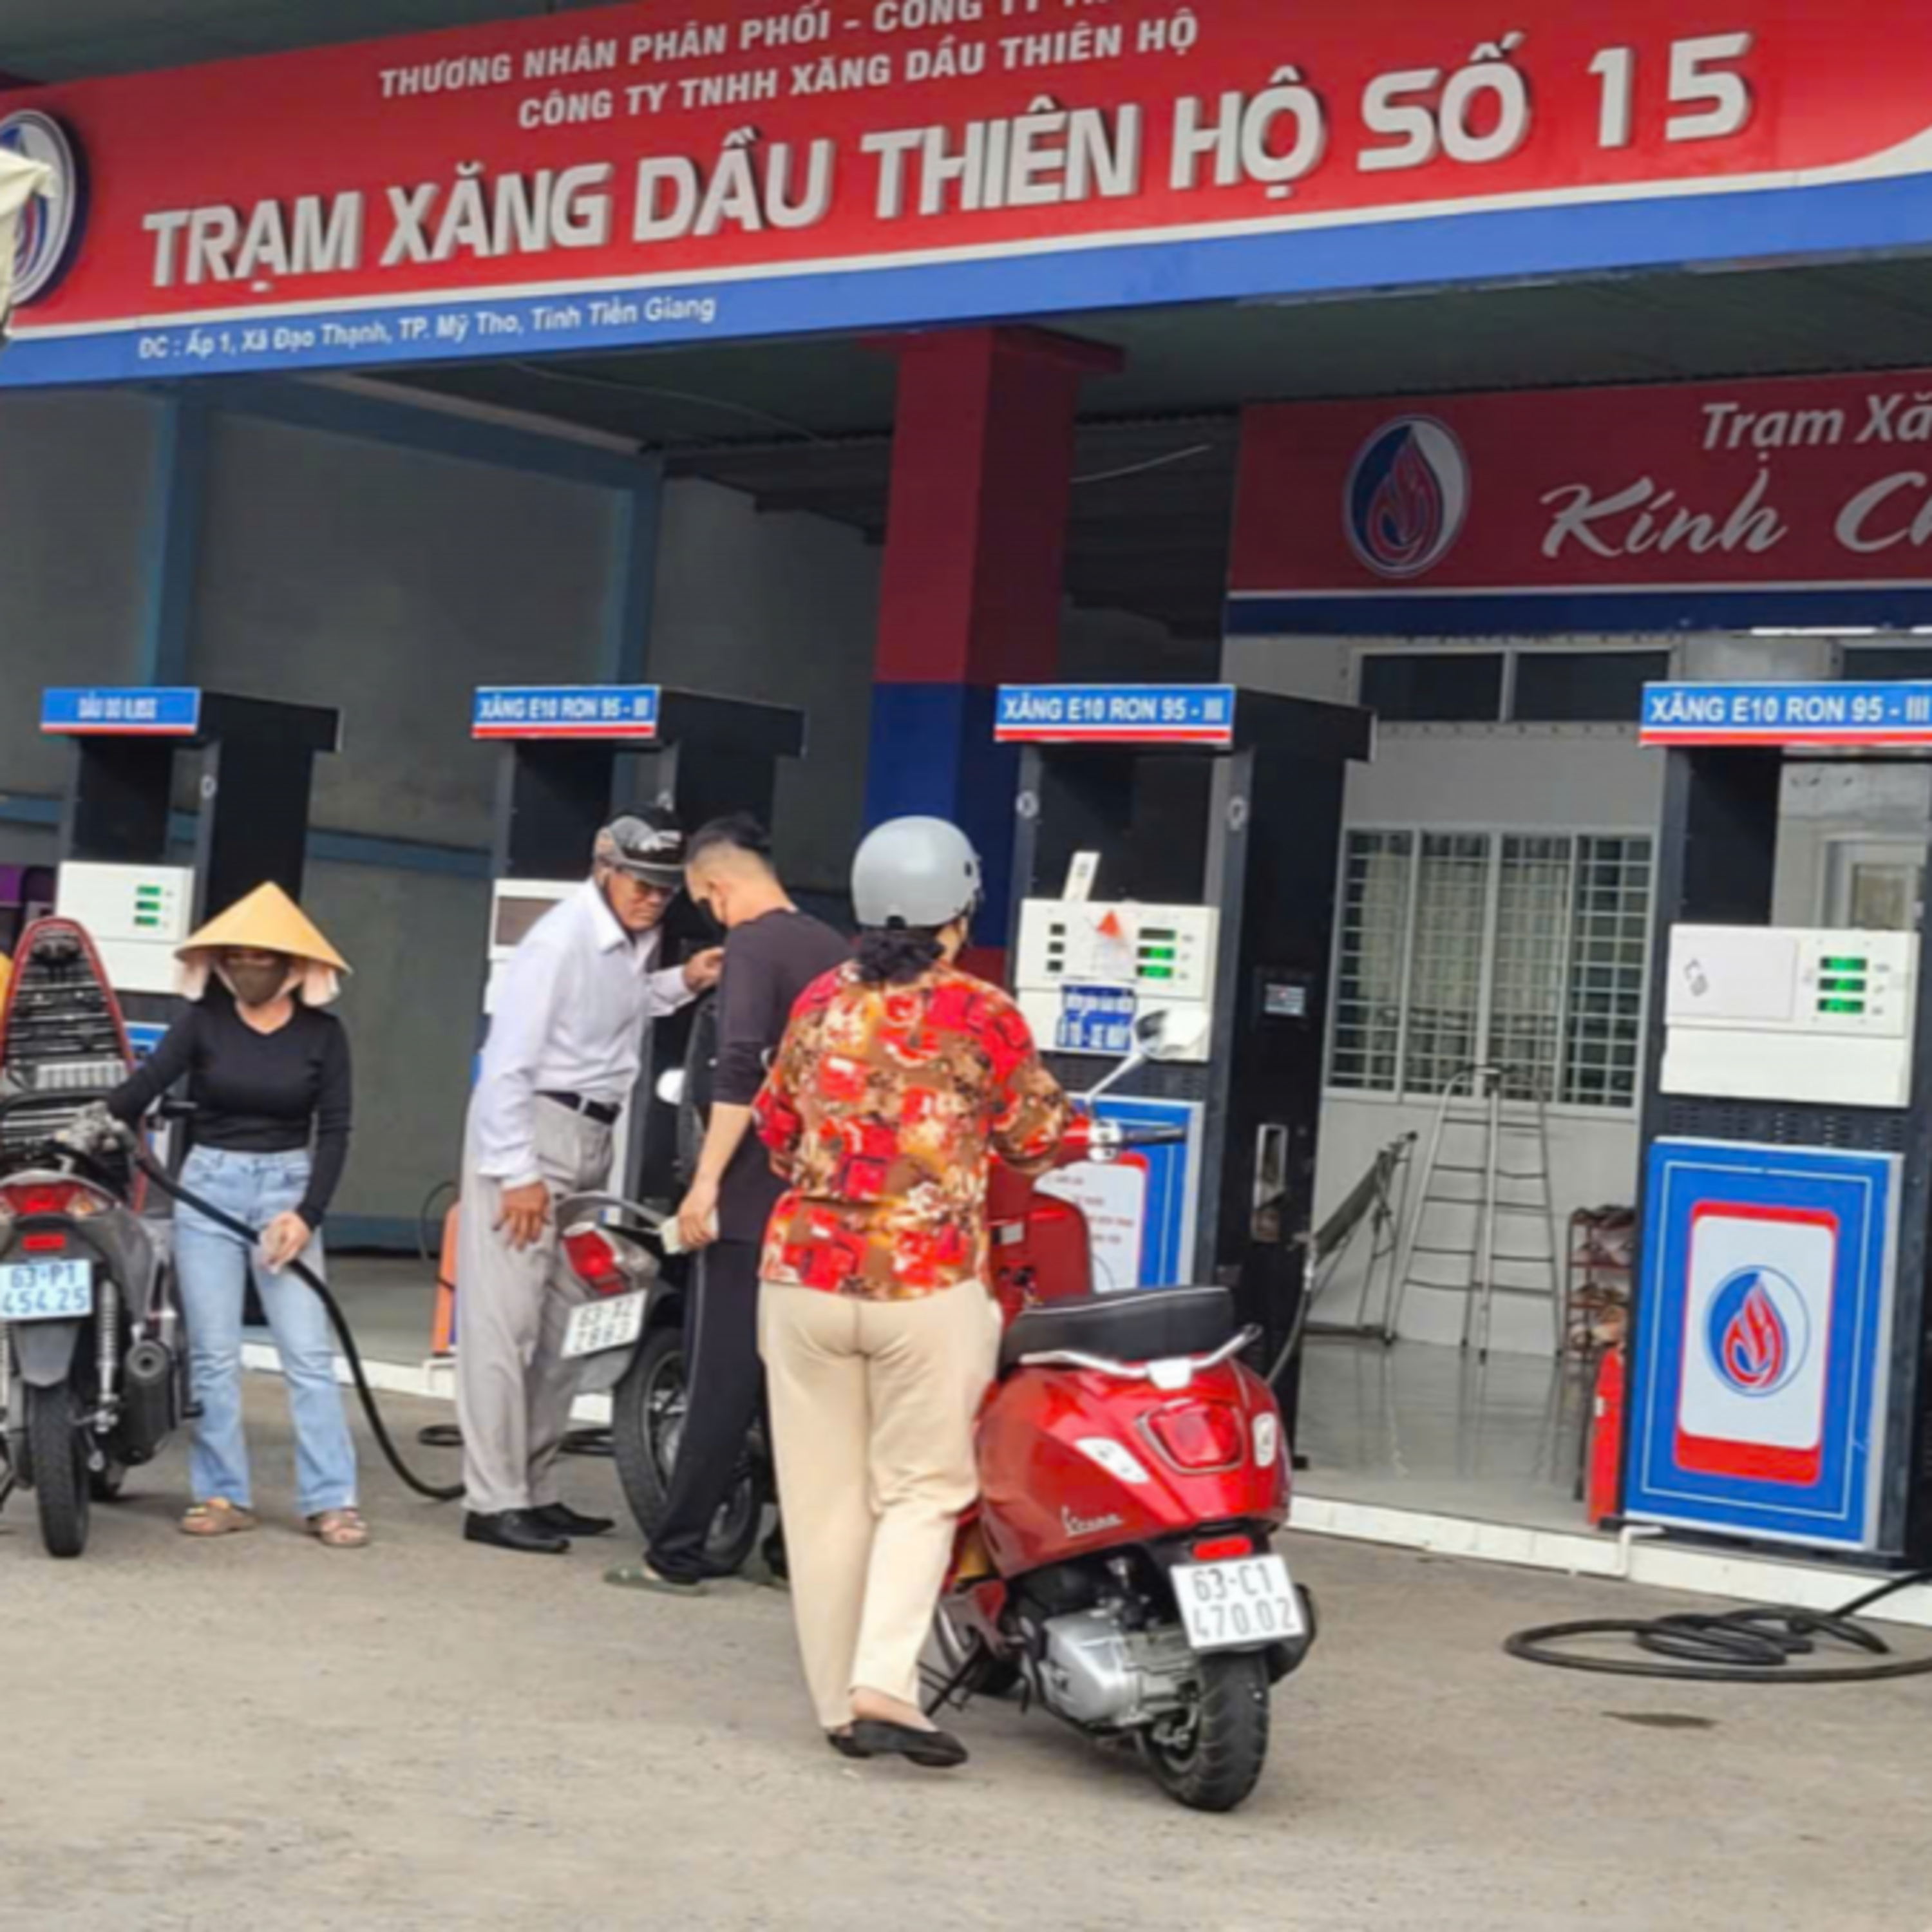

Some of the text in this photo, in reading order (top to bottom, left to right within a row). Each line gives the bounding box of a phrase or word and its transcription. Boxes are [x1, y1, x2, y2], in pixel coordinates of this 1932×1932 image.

[380, 54, 512, 97] THƯƠNG
[523, 36, 616, 78] NHÂN
[629, 22, 726, 64] PHÂN
[739, 0, 831, 50] PHỐI
[519, 90, 612, 129] CÔNG
[625, 82, 668, 115] TY
[680, 68, 777, 109] TNHH
[790, 55, 891, 95] XĂNG
[999, 22, 1122, 70] THIÊN
[1136, 8, 1198, 55] HỘ
[142, 191, 363, 292] TRẠM
[379, 160, 615, 267] XĂNG
[633, 126, 833, 243] DẦU
[860, 95, 1142, 220] THIÊN
[1169, 65, 1327, 199] HỘ
[1356, 30, 1531, 172] SỐ
[240, 328, 268, 354] Xã
[399, 316, 431, 341] TP.
[435, 314, 471, 345] Mỹ
[645, 297, 717, 323] Giang
[1701, 401, 1846, 462] Trạm
[1540, 468, 1789, 558] Kính
[479, 692, 525, 719] XĂNG
[561, 697, 596, 718] RON
[1003, 691, 1063, 721] XĂNG
[1067, 696, 1106, 721] E10
[1110, 697, 1157, 721] RON
[1162, 696, 1187, 721] 95
[1650, 691, 1725, 723] XĂNG
[1731, 696, 1779, 723] E10
[1785, 696, 1846, 723] RON
[1852, 696, 1883, 722] 95
[10, 1263, 76, 1289] 63-P1
[1191, 1562, 1273, 1602] 63-C1
